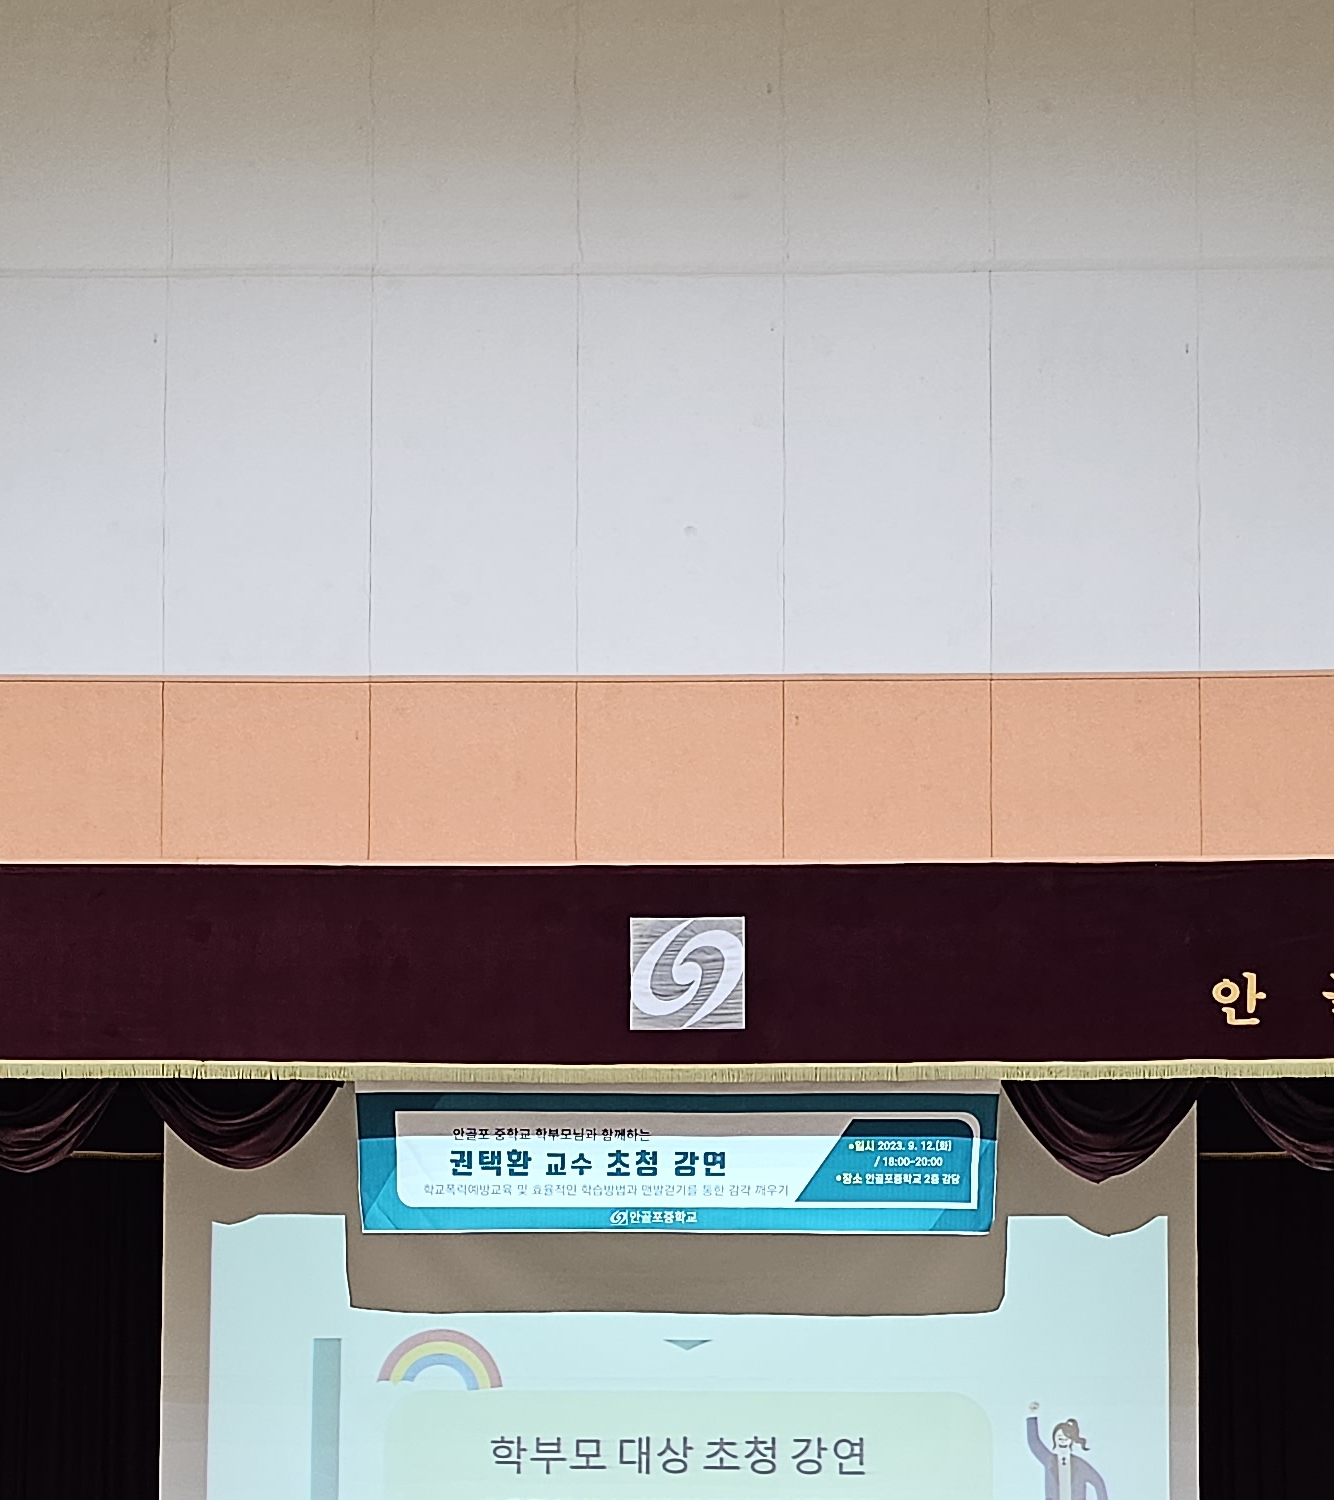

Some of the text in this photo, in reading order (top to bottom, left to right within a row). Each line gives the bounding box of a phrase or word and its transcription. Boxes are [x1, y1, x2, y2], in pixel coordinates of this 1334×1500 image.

[452, 1127, 652, 1142] 안골포 중학교 학부모님과 함께하는
[855, 1140, 875, 1152] 일시
[877, 1140, 906, 1152] 2023.
[907, 1140, 918, 1152] 9.
[450, 1149, 726, 1177] 권택환 교수 초청 강연
[842, 1172, 863, 1185] 장소
[423, 1183, 789, 1197] 학교폭력예방교육 및 효율적인 학습방법과 맨발걷기를 통한 감각 깨우기
[629, 1210, 698, 1225] 안골포중학교
[489, 1435, 869, 1477] 학부모 대상 초청 강연
